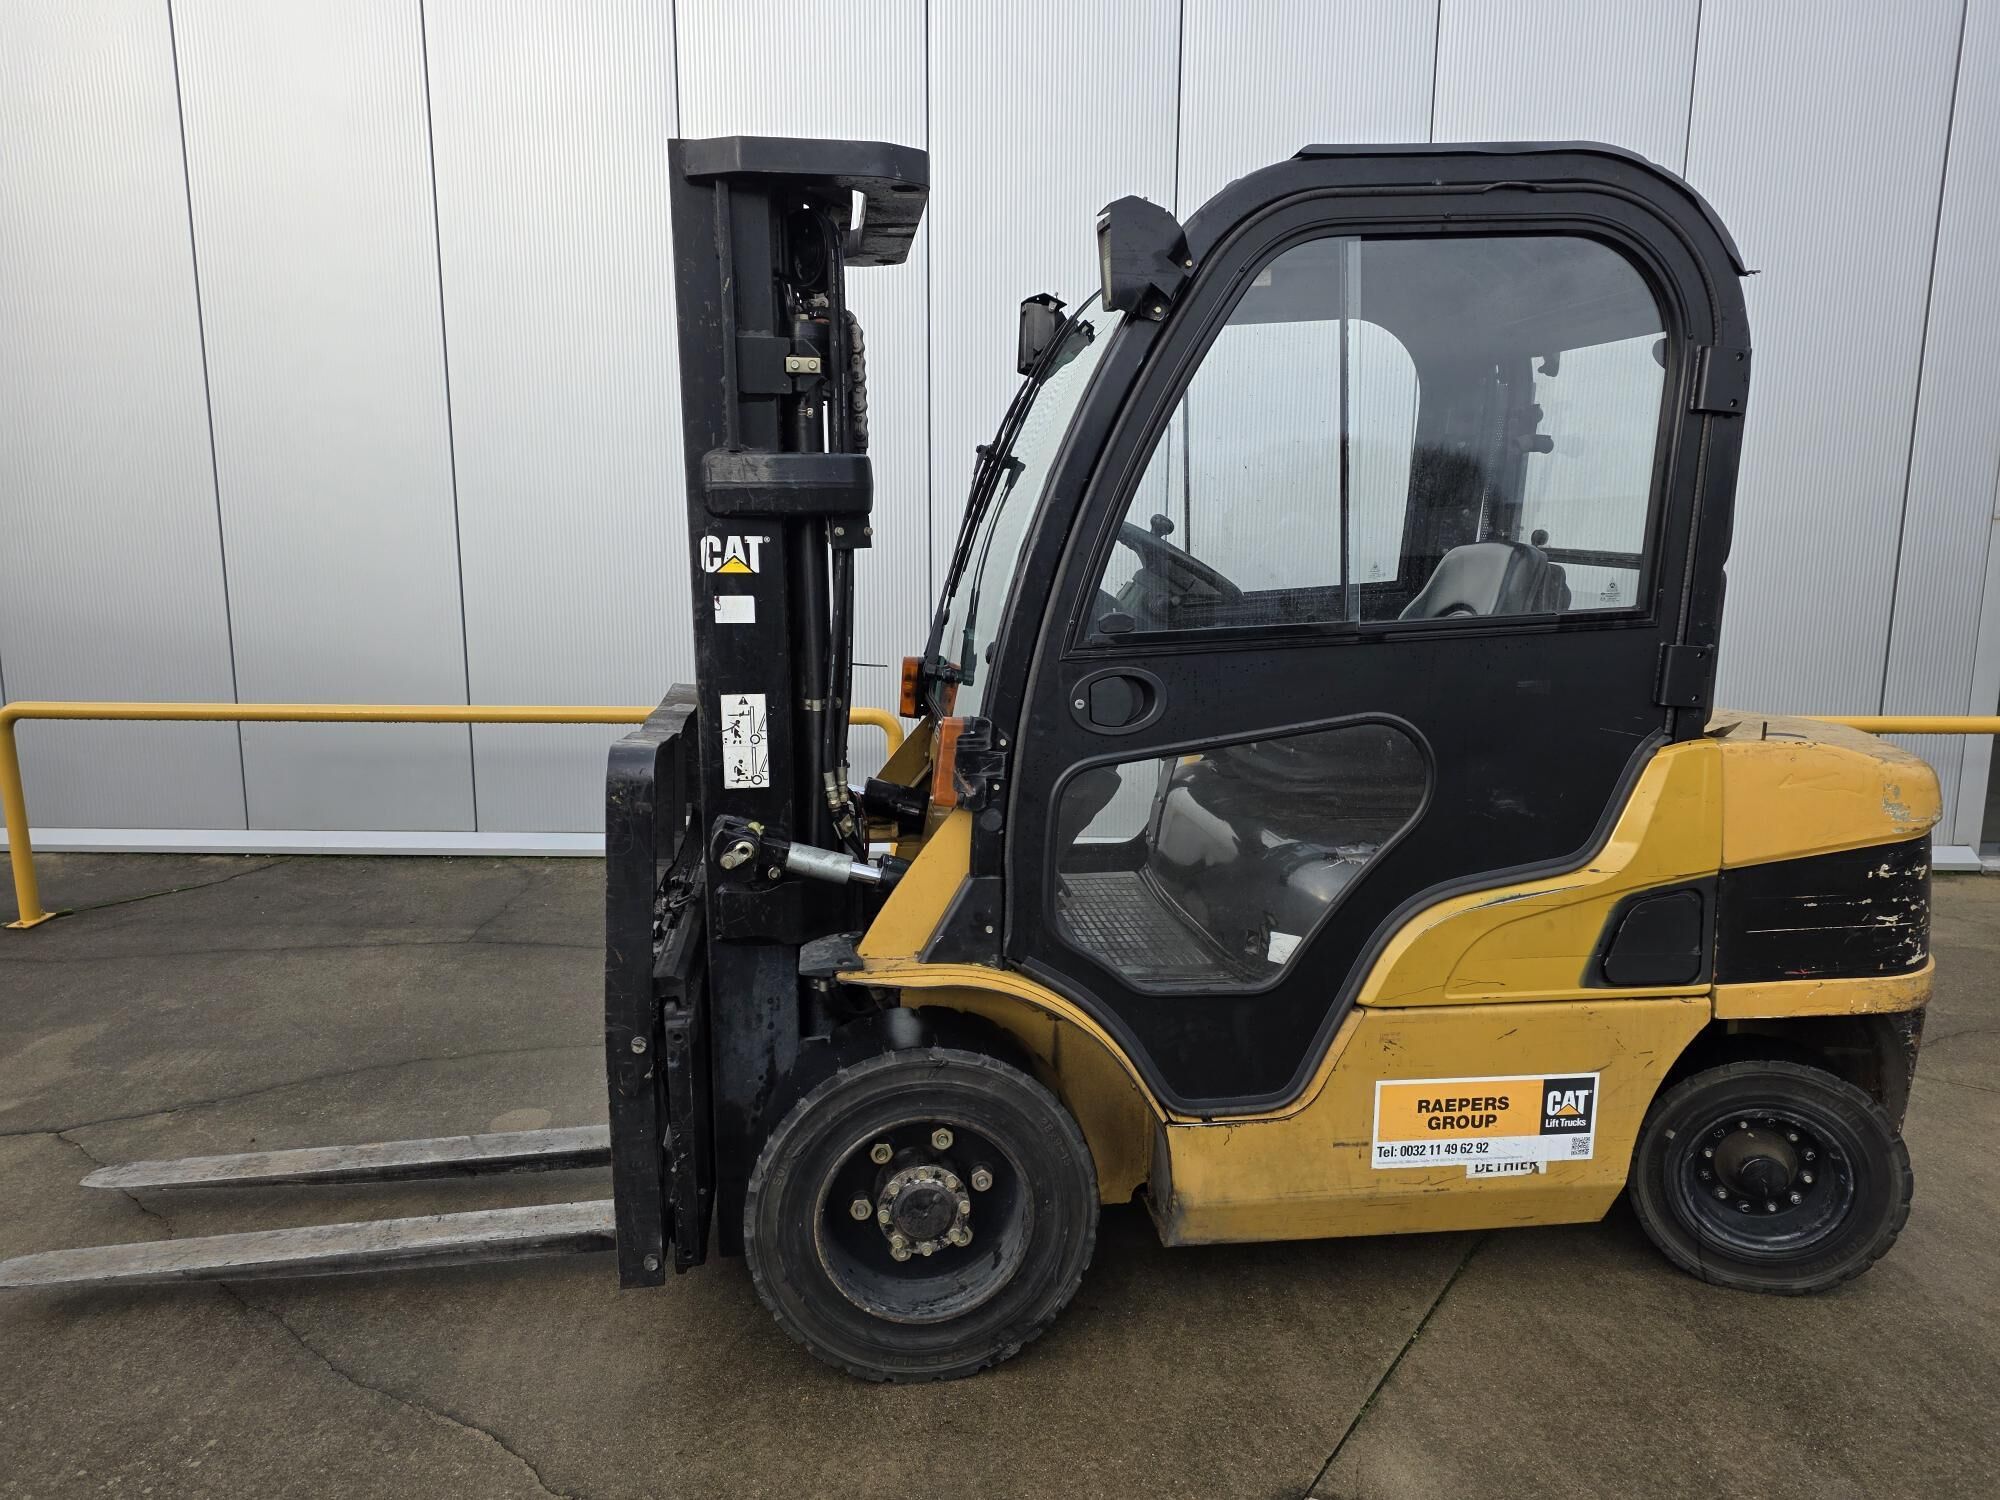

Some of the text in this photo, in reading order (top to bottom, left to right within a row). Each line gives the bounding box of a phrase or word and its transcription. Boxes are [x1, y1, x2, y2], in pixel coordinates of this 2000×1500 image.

[1417, 1096, 1510, 1114] RAEPERS
[1427, 1114, 1498, 1130] GROUP
[1545, 1117, 1587, 1128] Lift Trucks
[1377, 1141, 1489, 1158] Tel: 0032 11 49 62 92
